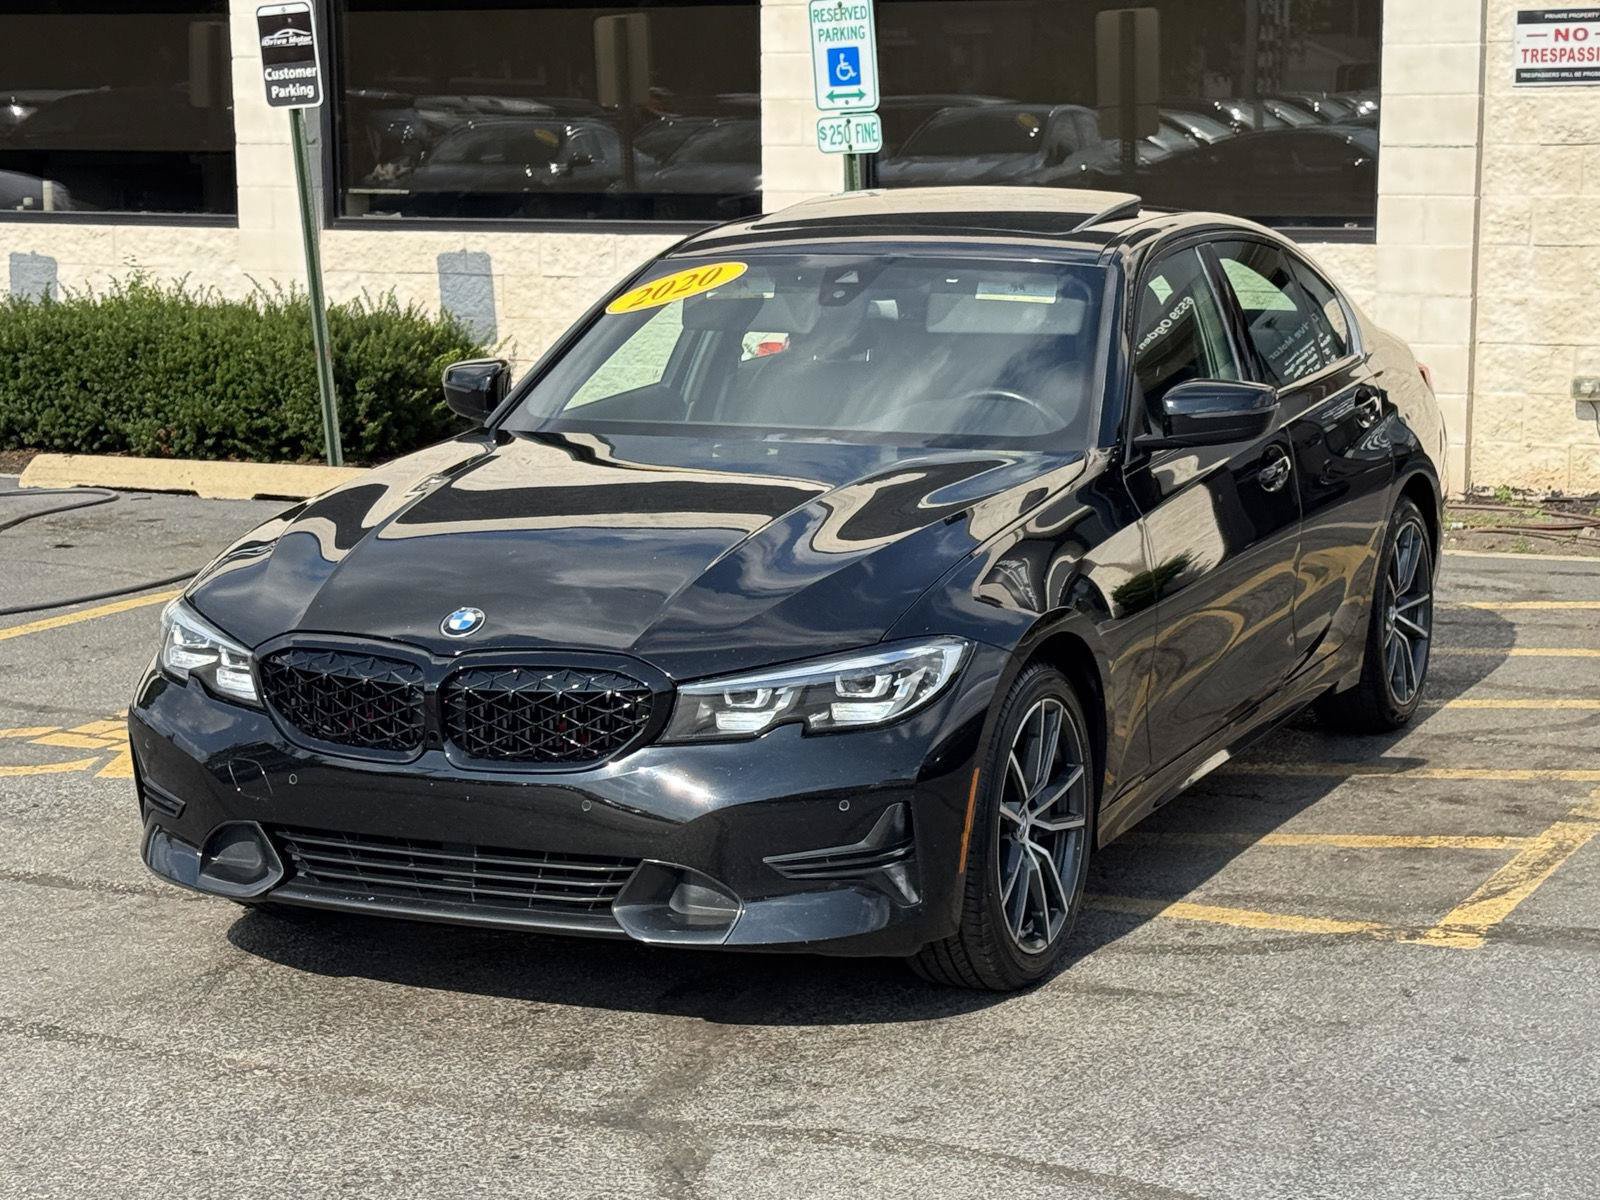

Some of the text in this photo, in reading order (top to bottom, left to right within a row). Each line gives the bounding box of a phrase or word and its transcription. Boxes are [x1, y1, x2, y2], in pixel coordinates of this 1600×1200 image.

[813, 5, 867, 23] RESERVED
[818, 25, 865, 42] PARKING
[1554, 28, 1589, 42] NO
[265, 67, 317, 81] Customer
[271, 83, 314, 98] Parking
[855, 122, 878, 144] FINE
[627, 267, 723, 309] 2020
